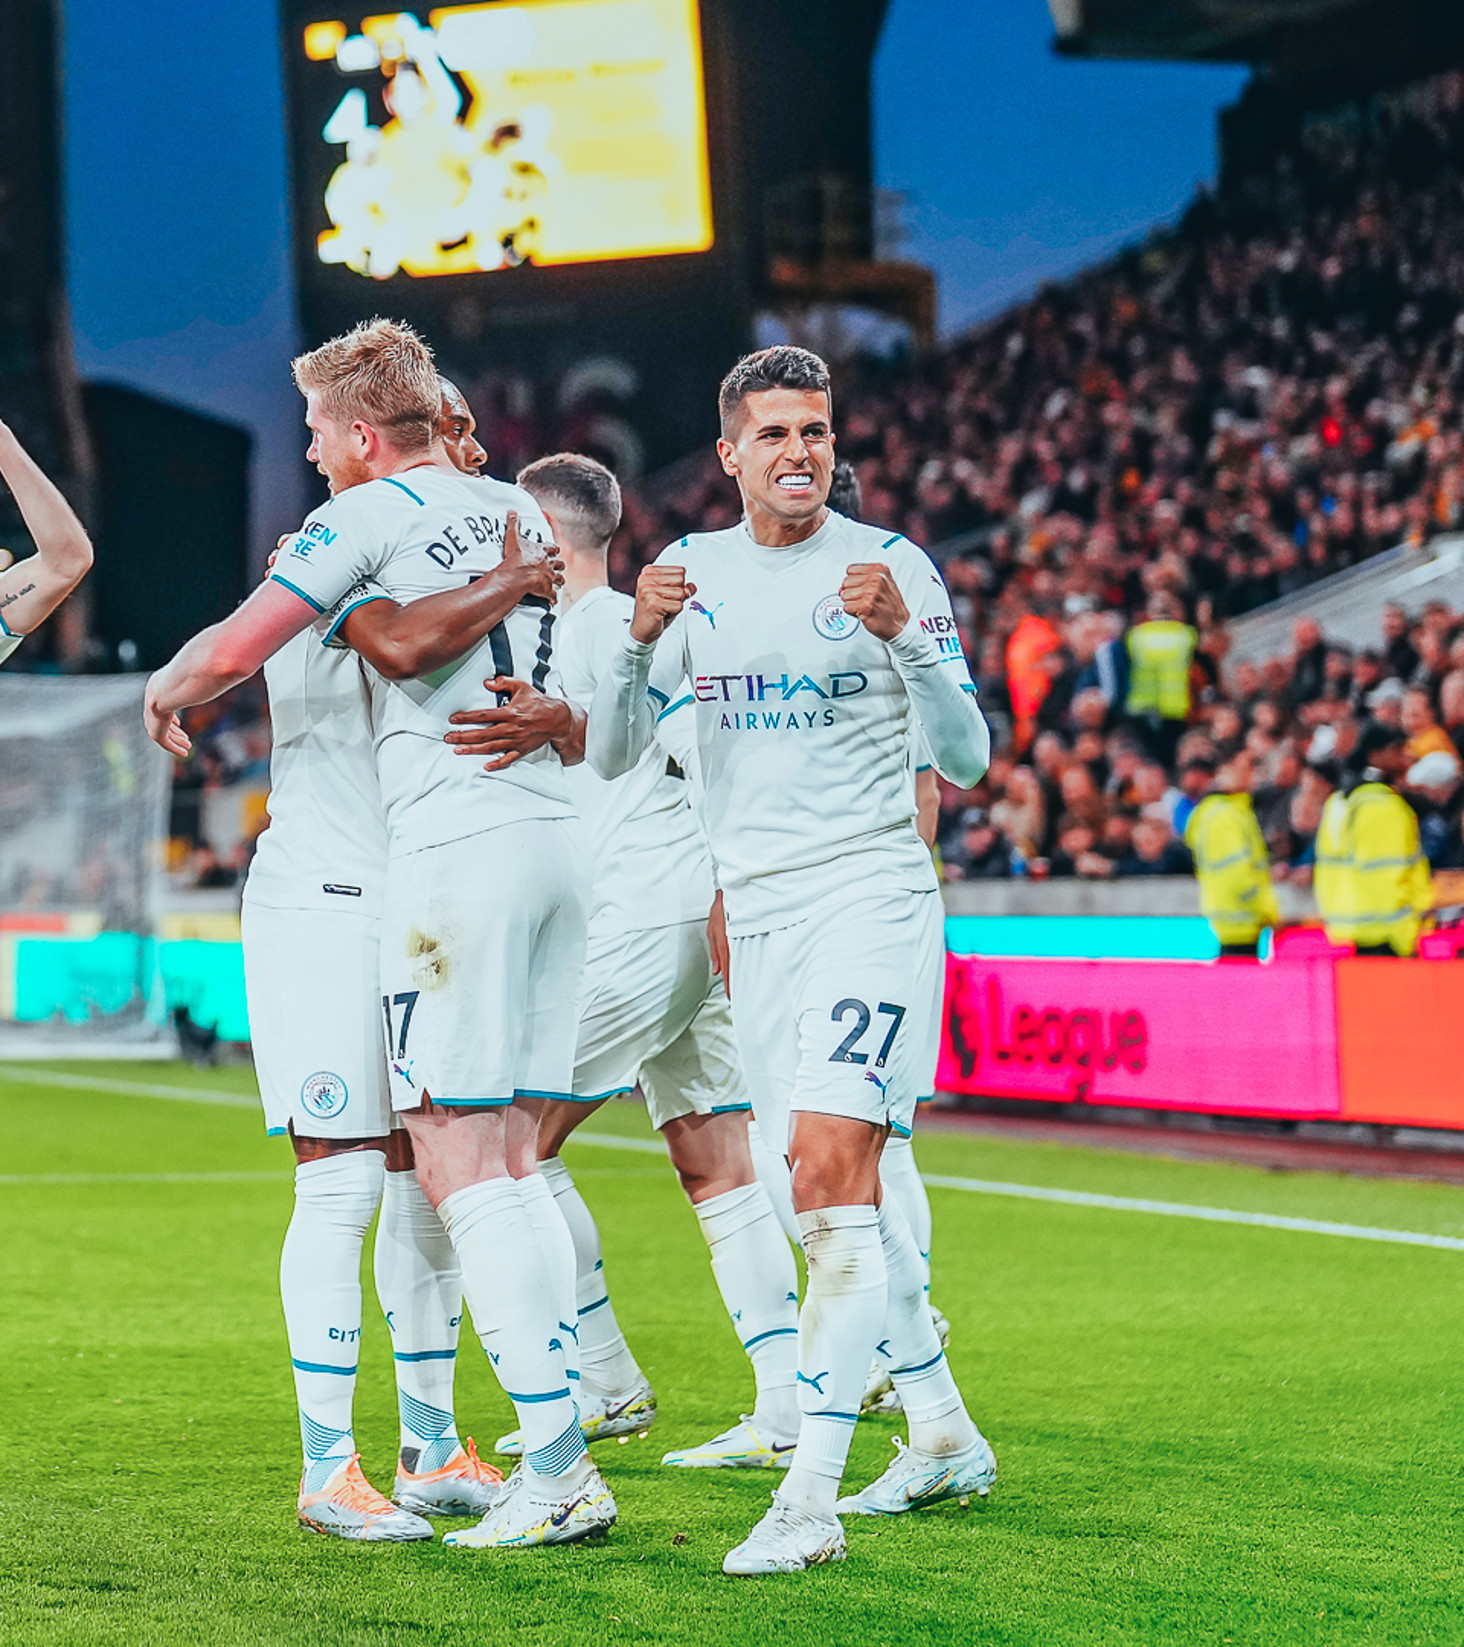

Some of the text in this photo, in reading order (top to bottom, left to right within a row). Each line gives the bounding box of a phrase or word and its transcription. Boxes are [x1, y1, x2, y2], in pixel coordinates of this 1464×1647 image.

[425, 516, 543, 570] DE BRU
[919, 615, 956, 635] NEX
[695, 671, 869, 702] ETIHAD
[720, 709, 835, 730] AIRWAYS
[382, 990, 420, 1061] 17
[828, 998, 906, 1068] 27
[990, 977, 1148, 1103] League
